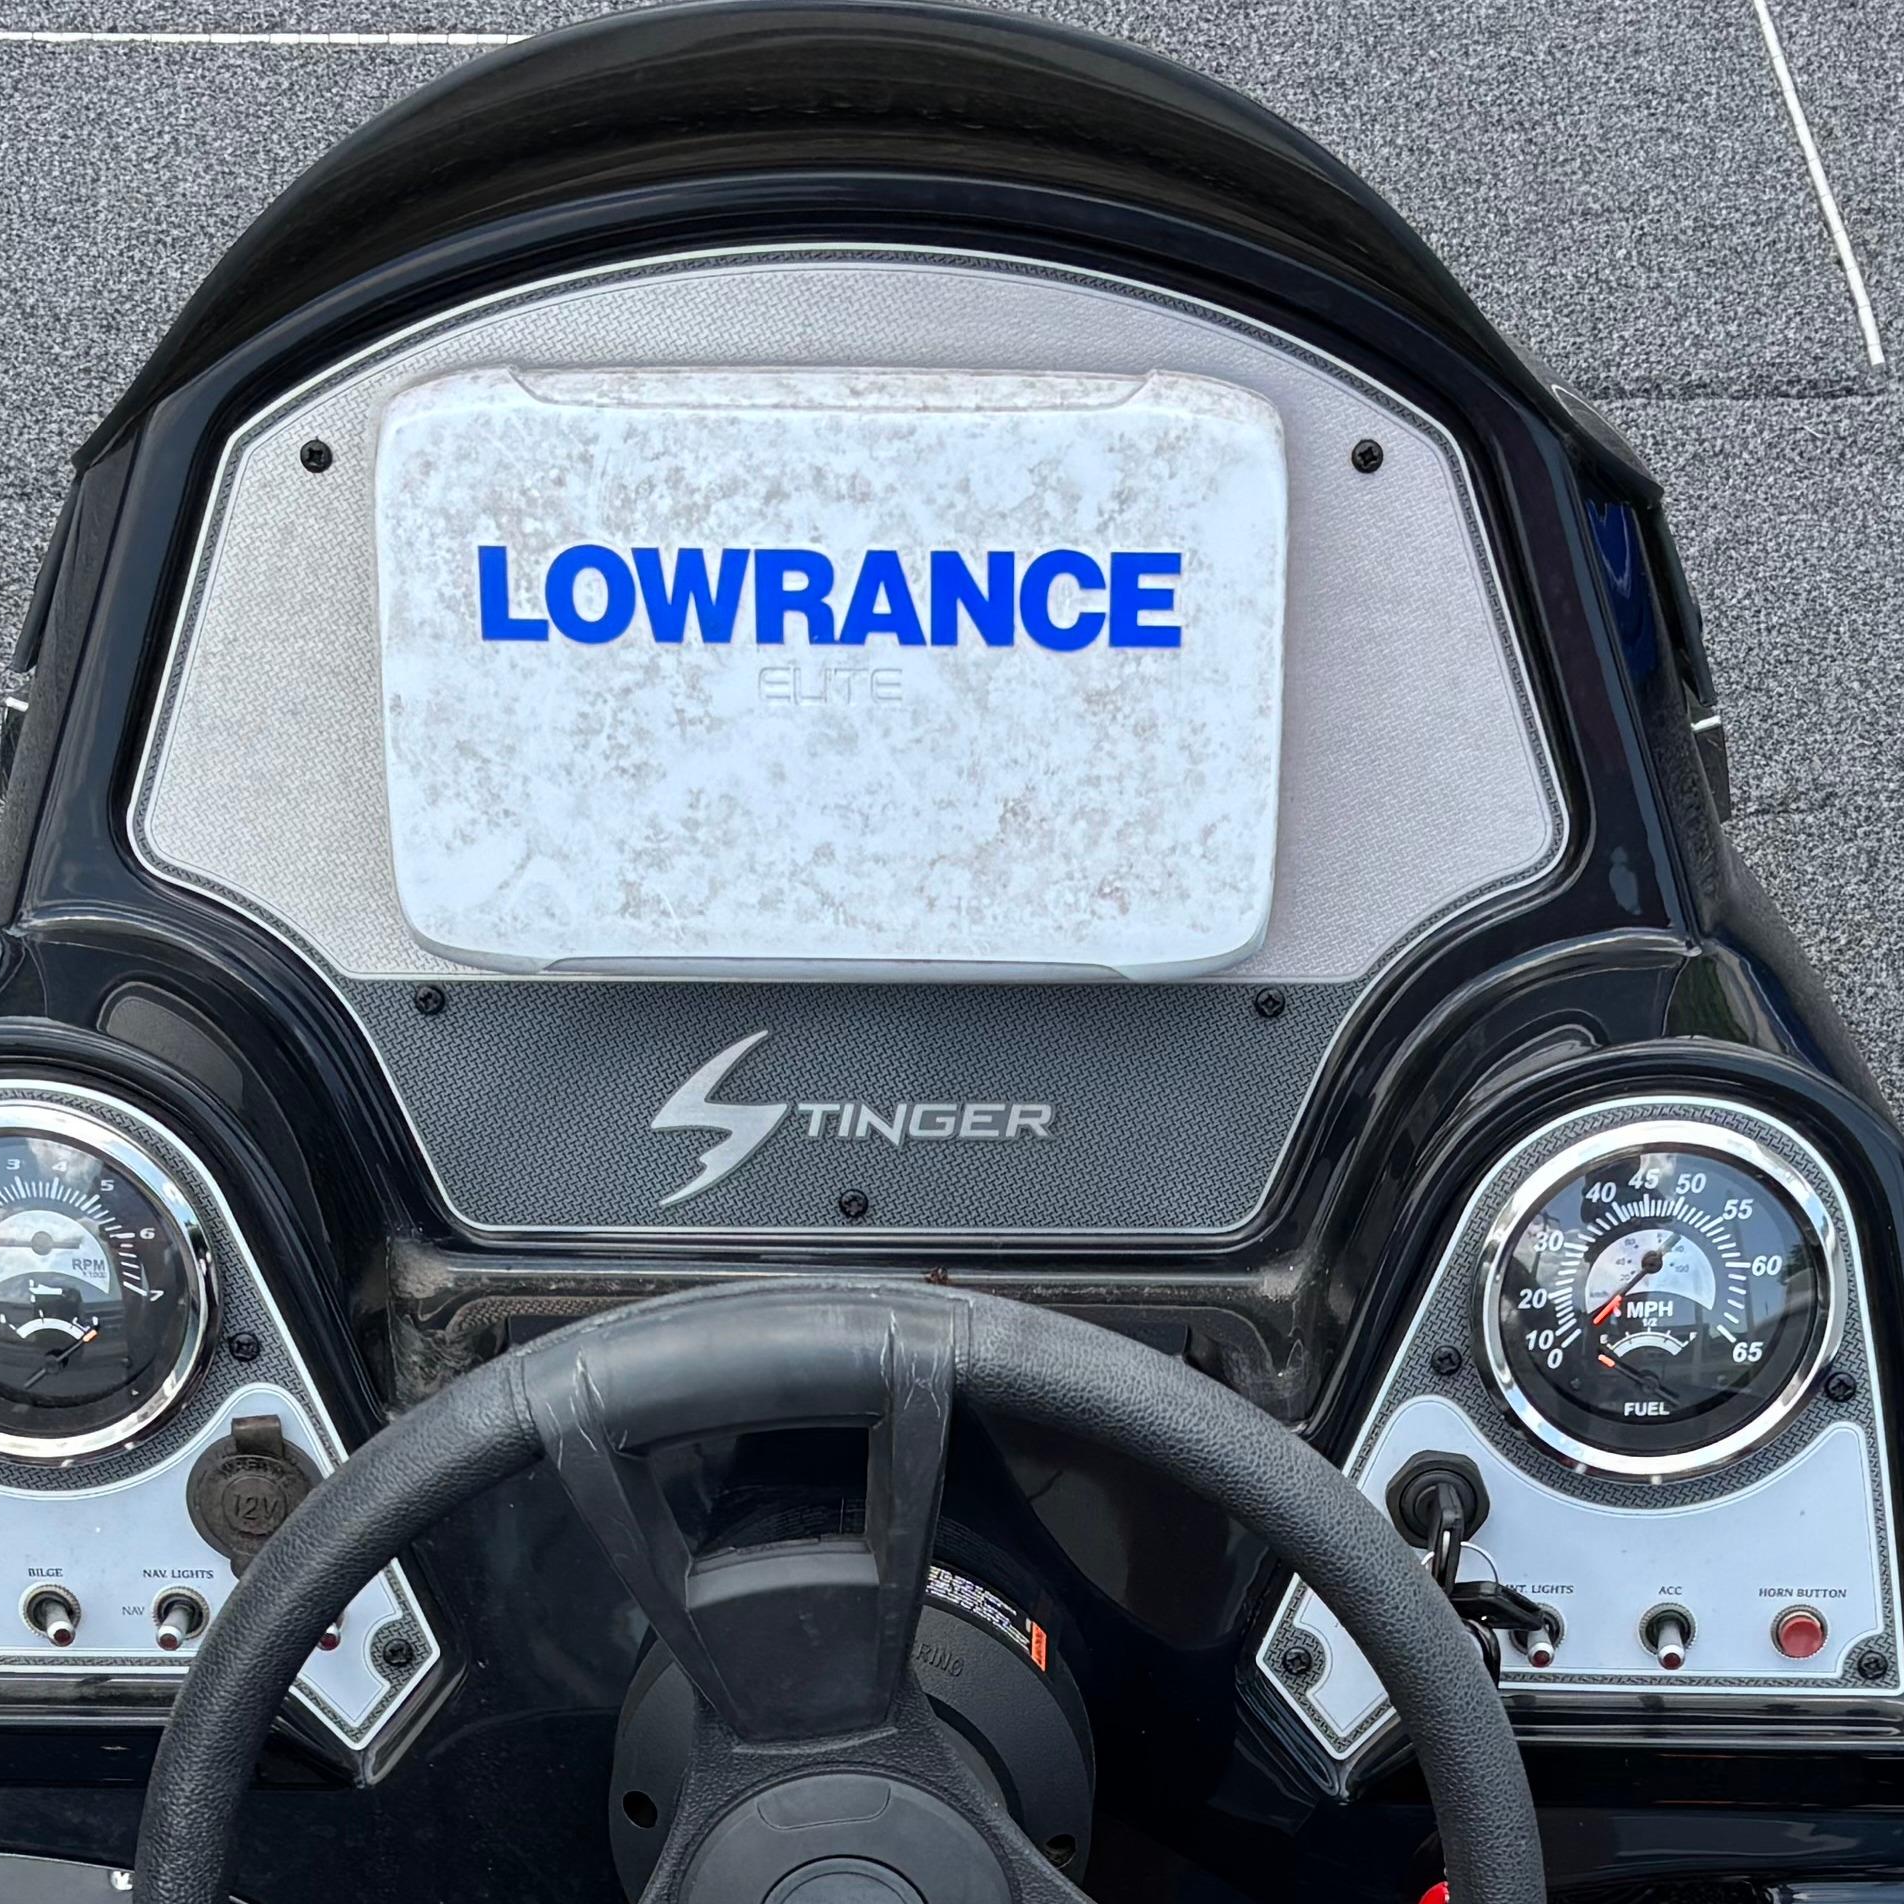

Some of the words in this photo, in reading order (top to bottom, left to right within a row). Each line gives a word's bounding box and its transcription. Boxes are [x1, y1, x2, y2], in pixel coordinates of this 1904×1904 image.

[478, 544, 1181, 651] LOWRANCE
[759, 667, 902, 704] ELITE
[651, 1030, 1053, 1206] STINGER
[6, 1159, 20, 1170] 3
[52, 1160, 68, 1172] 4
[100, 1180, 114, 1191] 5
[1628, 1168, 1660, 1190] 45
[1676, 1173, 1706, 1194] 50
[1586, 1182, 1616, 1203] 40
[1723, 1199, 1753, 1220] 55
[139, 1228, 155, 1240] 6
[1534, 1231, 1564, 1252] 30
[72, 1258, 105, 1271] RPM
[1752, 1255, 1782, 1276] 60
[149, 1290, 164, 1302] 7
[1518, 1289, 1547, 1309] 20
[1626, 1301, 1673, 1318] MPH
[1525, 1330, 1554, 1350] 10
[1547, 1349, 1563, 1368] 0
[1732, 1341, 1763, 1363] 65
[1624, 1402, 1670, 1417] FUEL
[233, 1494, 278, 1520] 12V
[28, 1568, 63, 1578] BILGE
[171, 1569, 215, 1580] LIGHTS
[1532, 1584, 1574, 1594] LIGHTS
[1658, 1586, 1683, 1596] ACC
[1758, 1588, 1793, 1599] HORN
[1797, 1588, 1847, 1599] BUTTON
[122, 1605, 145, 1616] NAV
